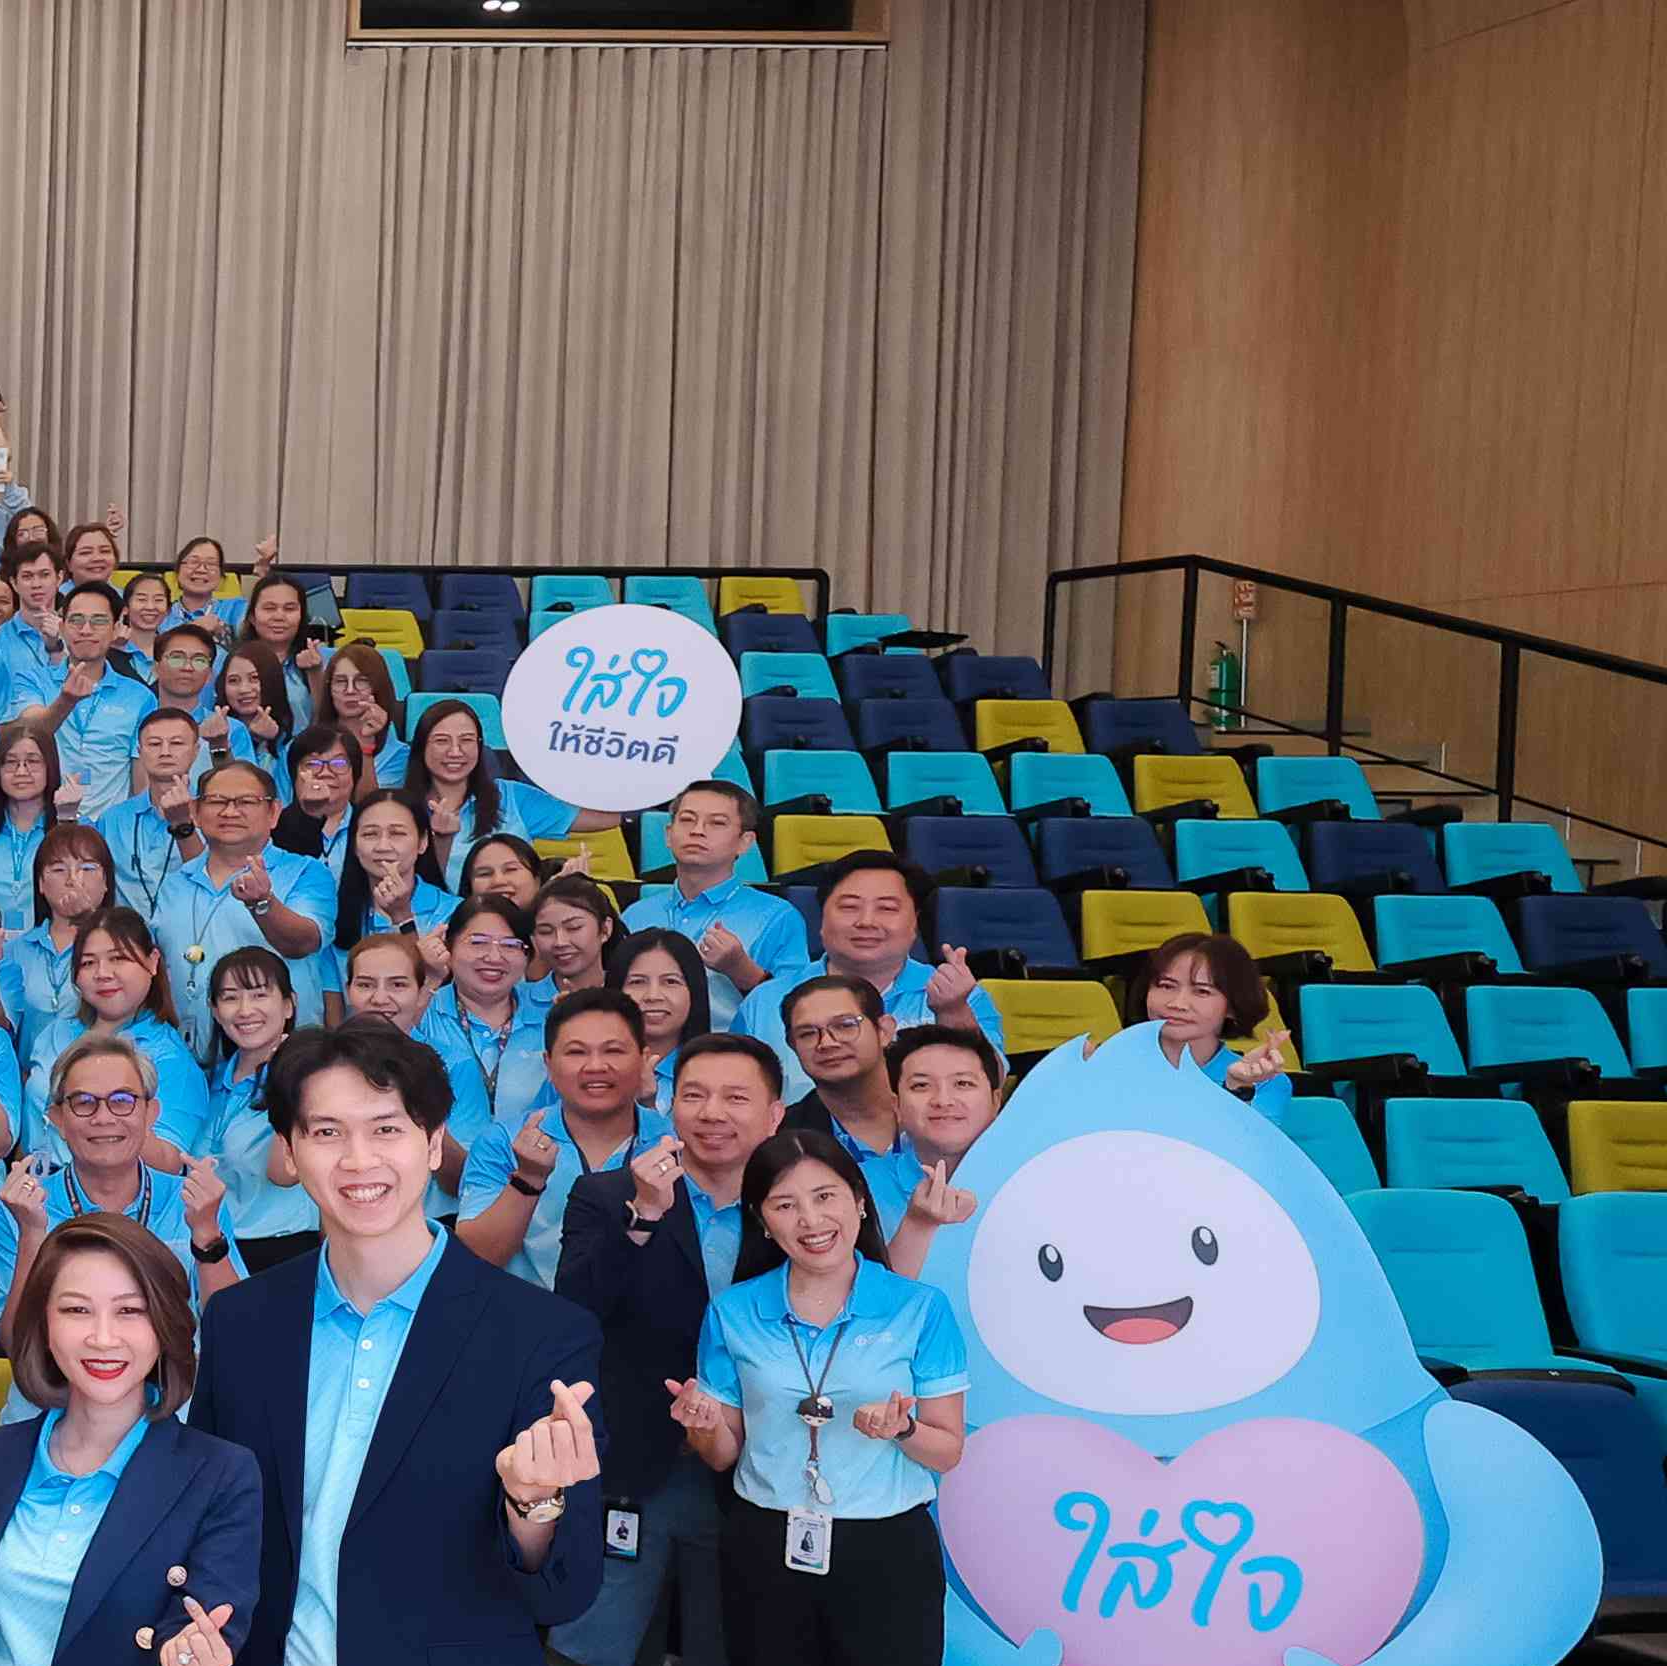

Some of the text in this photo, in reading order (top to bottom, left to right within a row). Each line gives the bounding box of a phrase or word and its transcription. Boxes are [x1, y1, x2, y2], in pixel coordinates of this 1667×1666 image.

[562, 646, 688, 718] ใส่ใจ
[548, 720, 680, 765] ให้ชีวิตดี
[1053, 1491, 1303, 1632] ใส่ใจ
